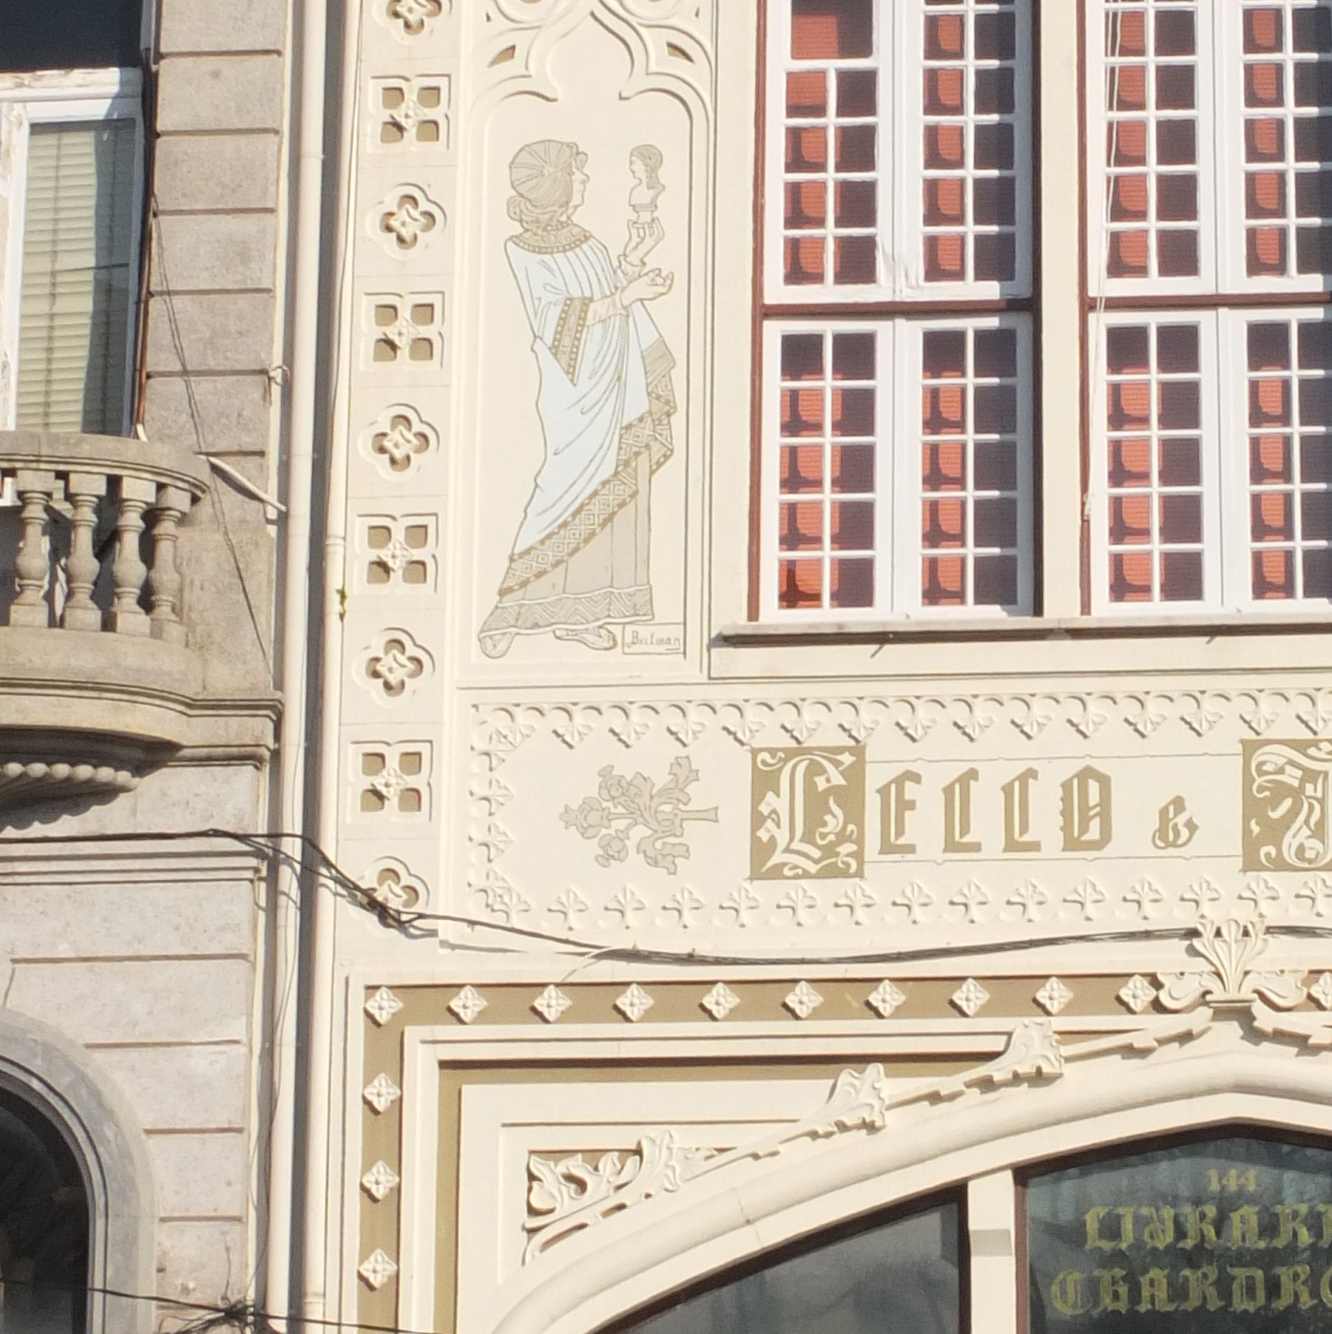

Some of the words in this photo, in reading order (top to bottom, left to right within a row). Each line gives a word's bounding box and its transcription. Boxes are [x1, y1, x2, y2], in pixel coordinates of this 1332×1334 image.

[757, 749, 1112, 875] LELLO
[1150, 794, 1200, 849] &
[1208, 1169, 1257, 1193] 144
